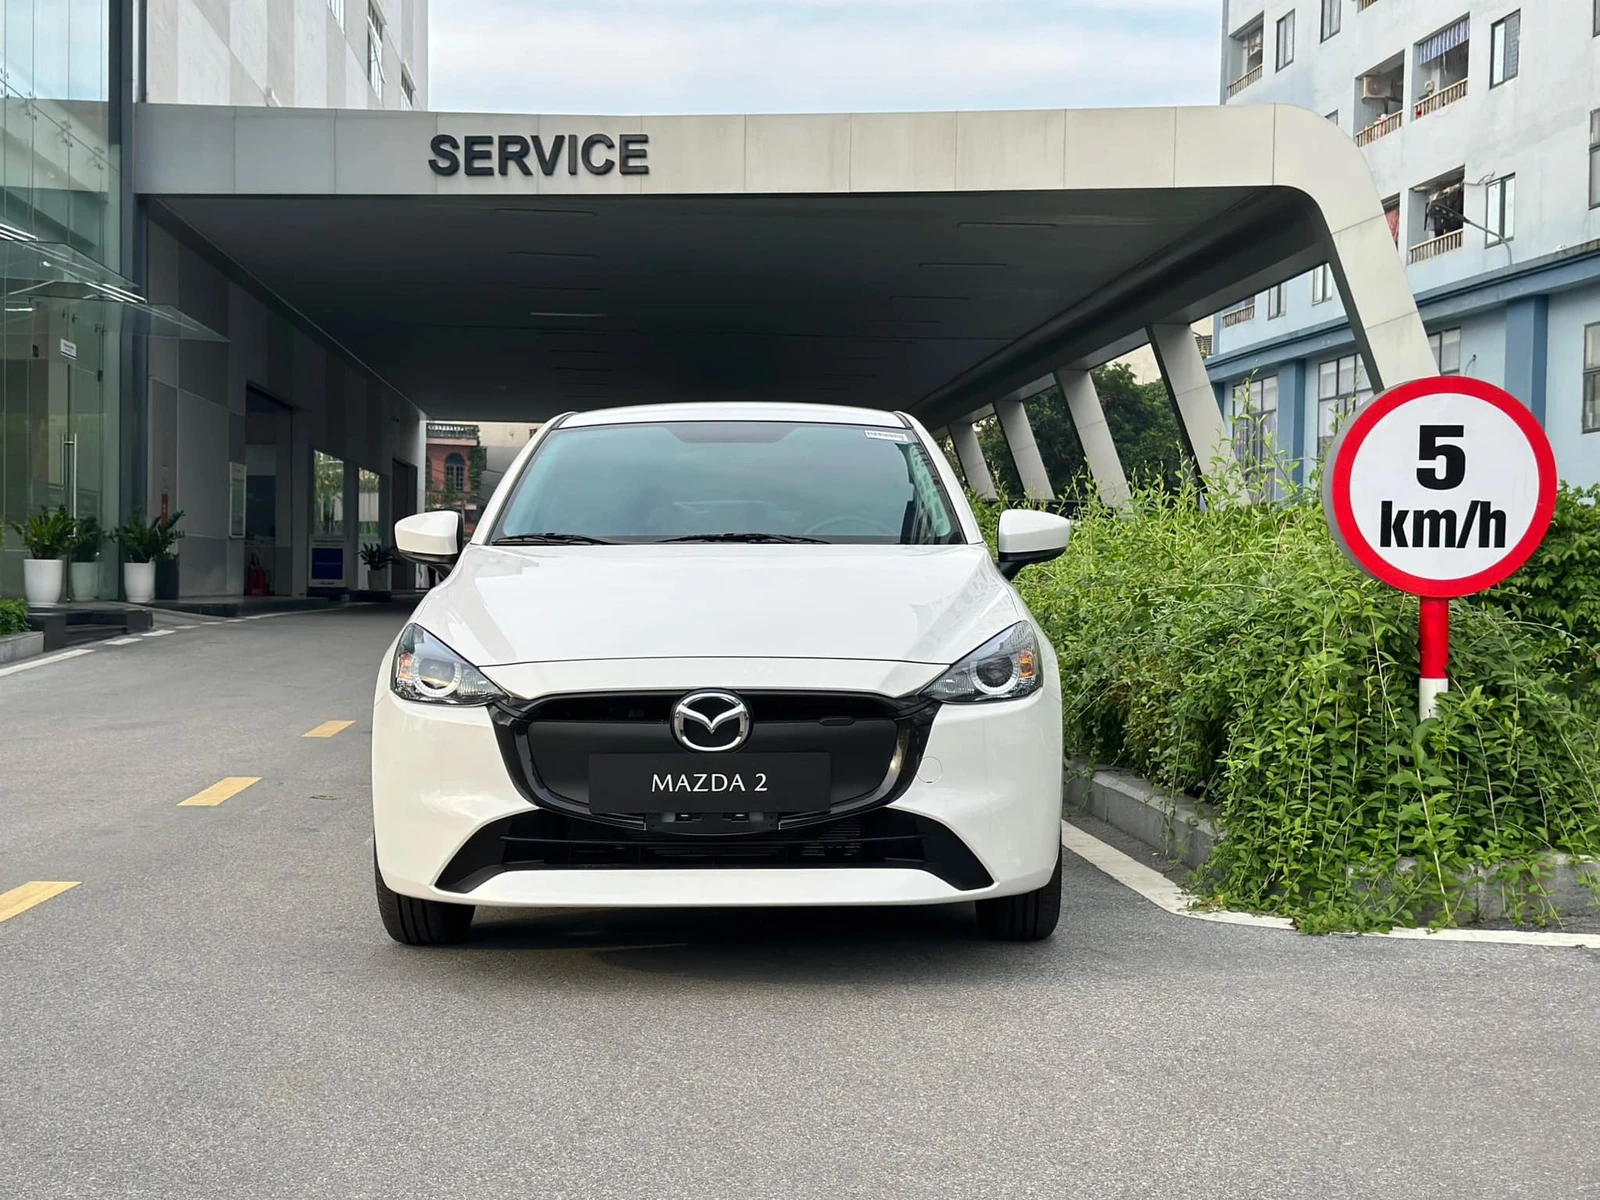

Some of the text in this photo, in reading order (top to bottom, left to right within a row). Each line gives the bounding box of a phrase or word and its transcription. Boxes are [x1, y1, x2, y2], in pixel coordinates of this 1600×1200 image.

[428, 133, 650, 176] SERVICE
[1416, 425, 1466, 490] 5
[1380, 500, 1506, 549] km/h
[651, 773, 768, 793] MAZDA 2
